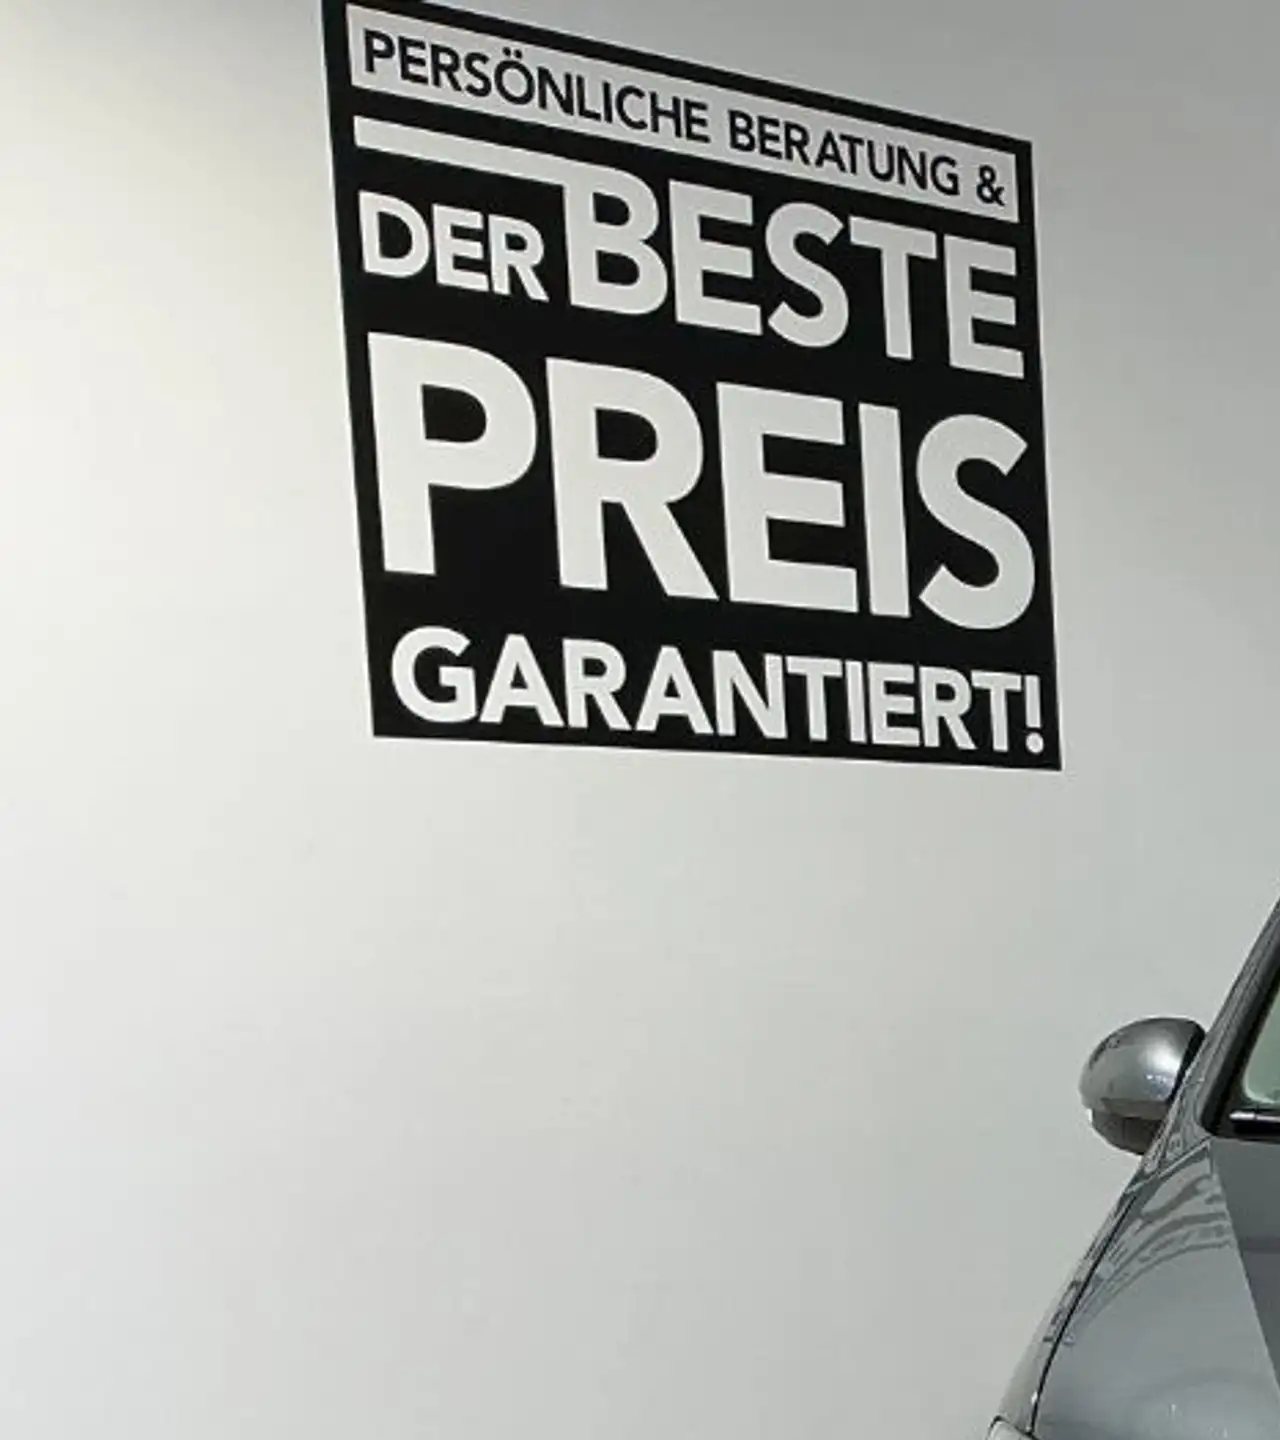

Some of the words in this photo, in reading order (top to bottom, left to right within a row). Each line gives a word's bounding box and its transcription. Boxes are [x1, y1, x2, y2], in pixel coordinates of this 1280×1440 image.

[363, 30, 710, 144] PERSÖNLICHE
[728, 108, 960, 197] BERATUNG
[976, 164, 1006, 207] &
[357, 190, 549, 303] DER
[561, 160, 1026, 380] BESTE
[366, 331, 1036, 631] PREIS
[390, 626, 1045, 754] GARANTIERT!
